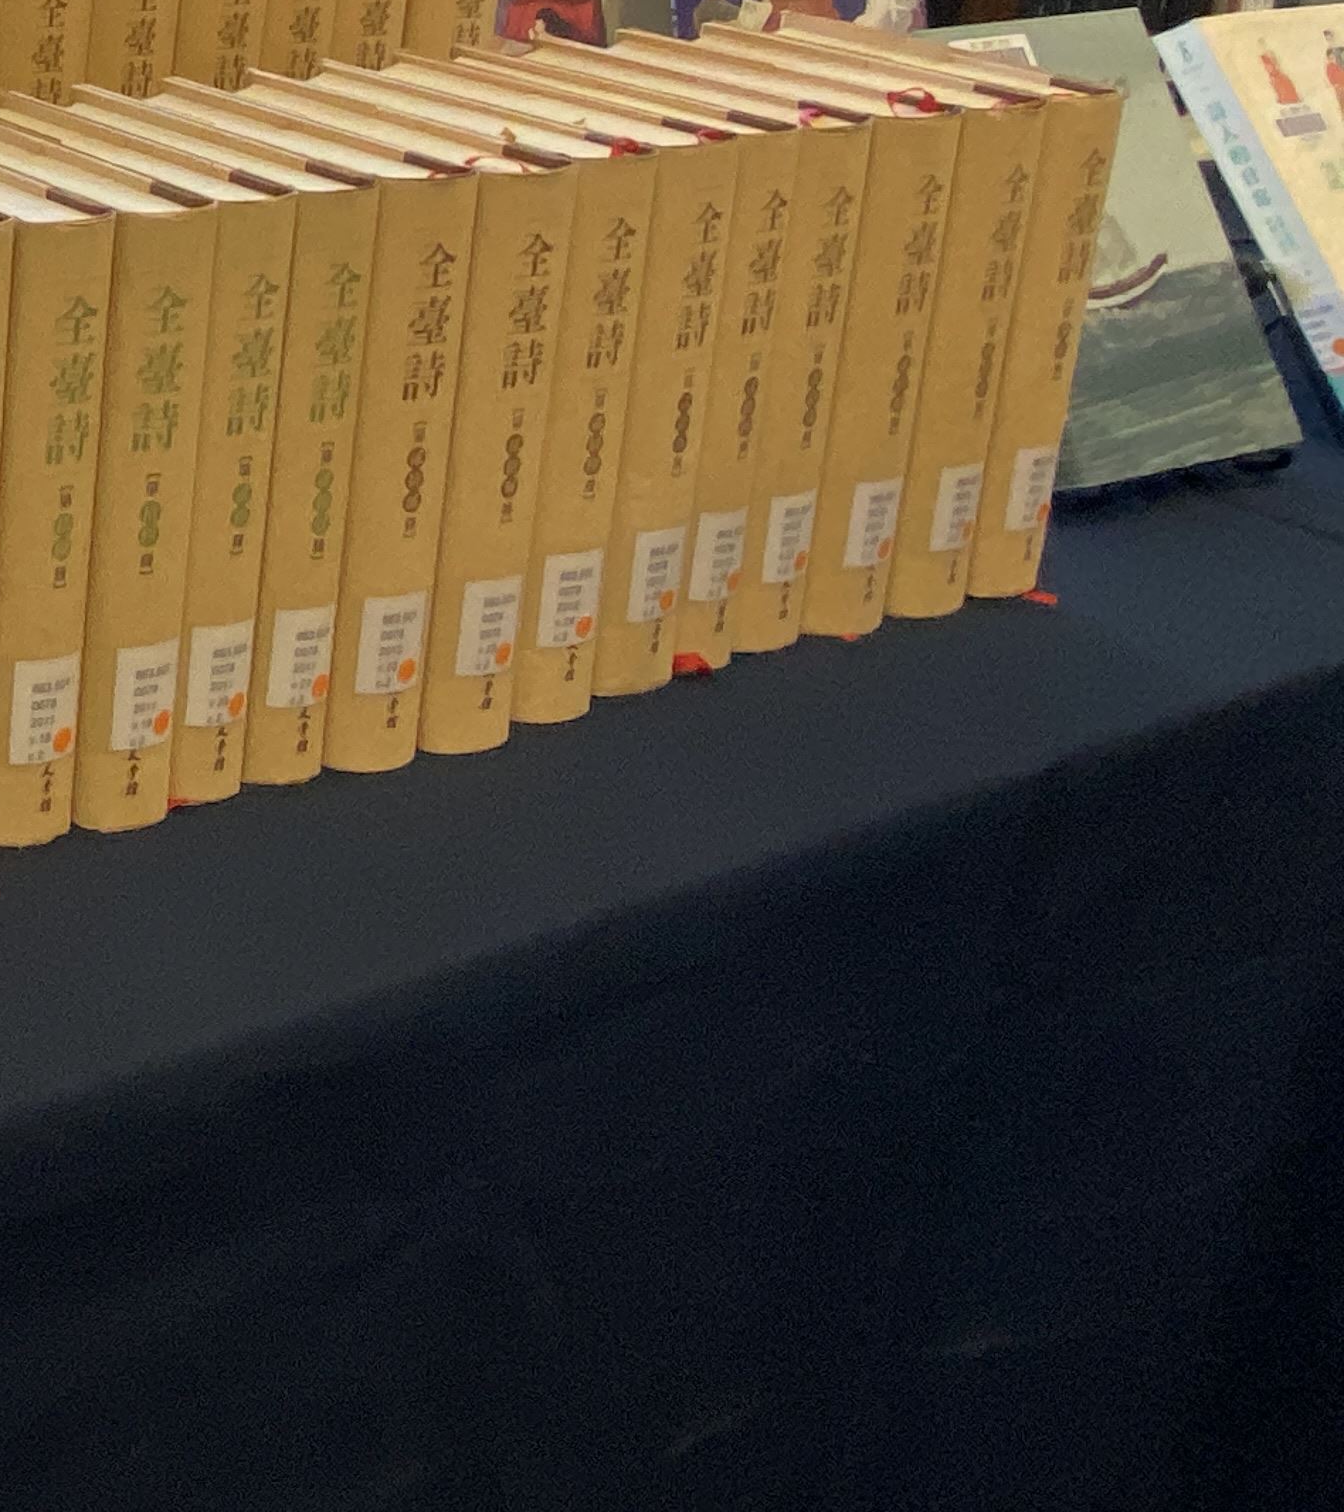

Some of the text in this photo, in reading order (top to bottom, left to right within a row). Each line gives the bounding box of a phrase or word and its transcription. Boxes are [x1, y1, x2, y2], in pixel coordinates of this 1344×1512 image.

[676, 202, 723, 351] 全臺詩
[740, 189, 788, 337] 全臺詩
[805, 186, 854, 332] 全臺詩
[895, 173, 944, 316] 全臺詩
[980, 163, 1030, 303] 全臺詩
[1058, 147, 1107, 286] 全臺詩
[225, 273, 280, 437] 全臺詩
[310, 262, 361, 424] 全臺詩
[402, 242, 457, 402] 全臺詩
[502, 233, 555, 390] 全臺詩
[586, 217, 637, 369] 全臺詩
[45, 294, 98, 466] 全臺詩
[130, 285, 189, 455] 全臺詩
